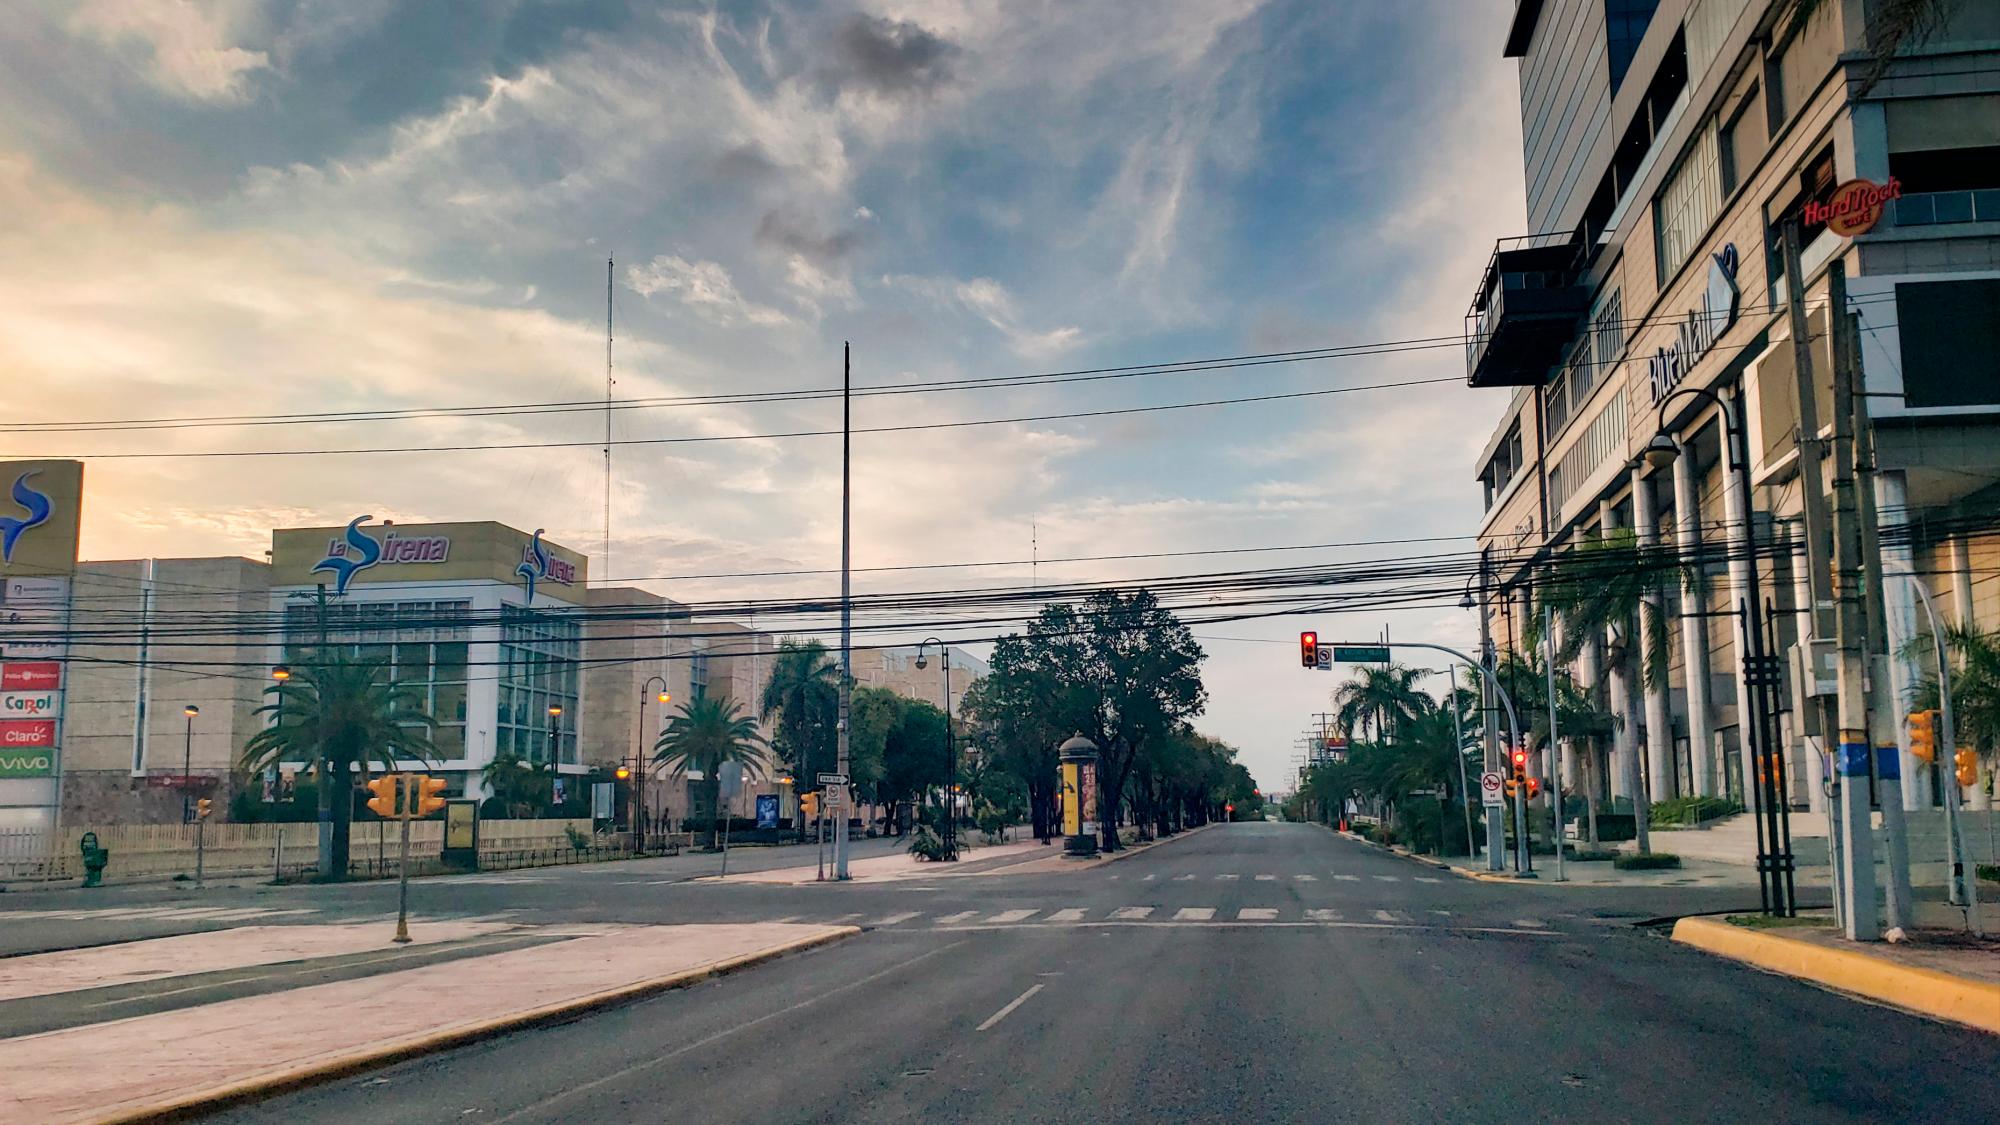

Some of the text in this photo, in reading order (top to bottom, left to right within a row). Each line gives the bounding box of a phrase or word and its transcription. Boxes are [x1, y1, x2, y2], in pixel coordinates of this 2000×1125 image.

[1803, 175, 1902, 226] Hard Rock
[327, 539, 347, 558] La
[5, 729, 42, 743] Claro
